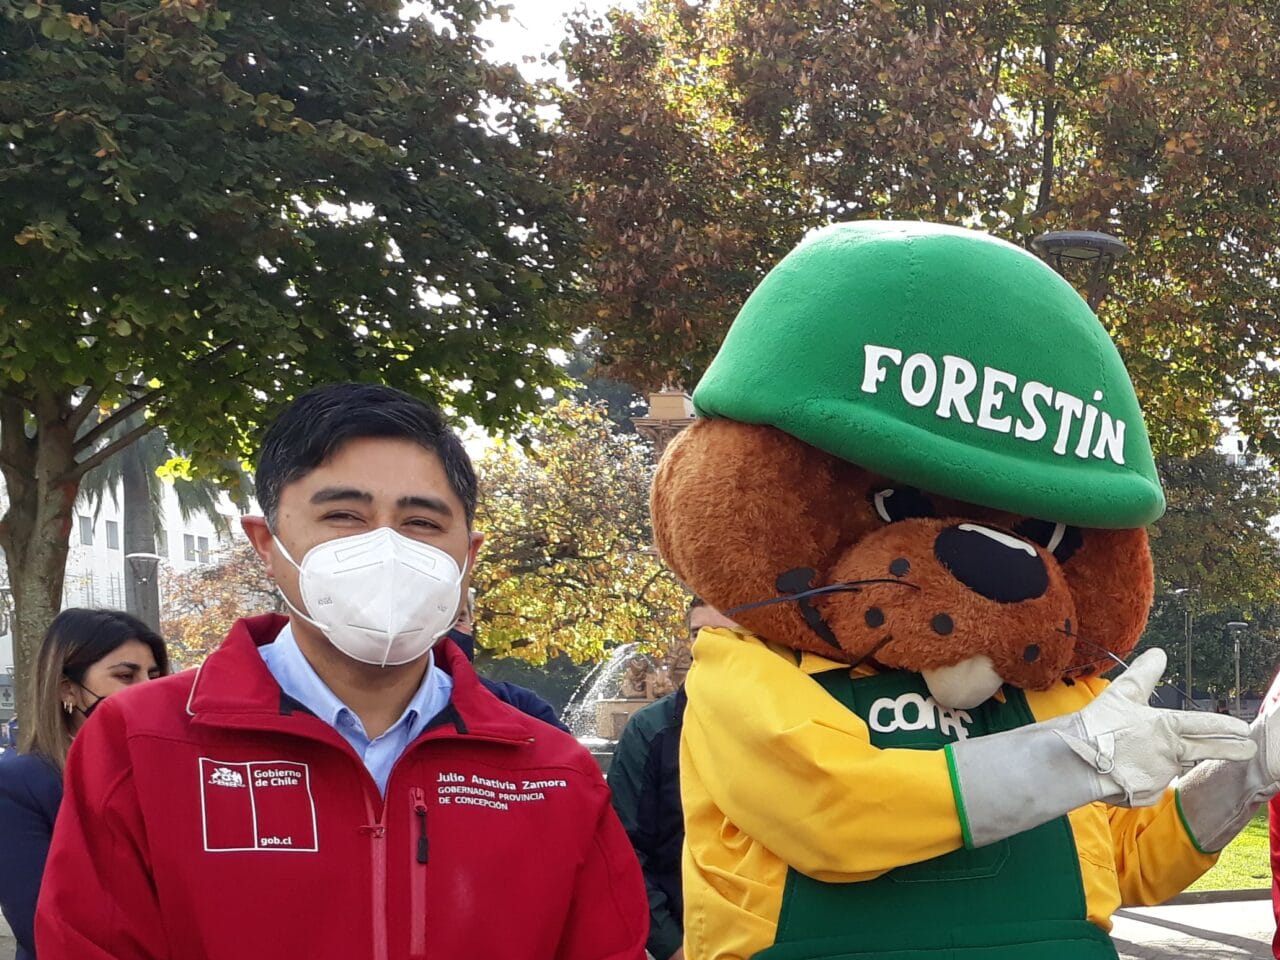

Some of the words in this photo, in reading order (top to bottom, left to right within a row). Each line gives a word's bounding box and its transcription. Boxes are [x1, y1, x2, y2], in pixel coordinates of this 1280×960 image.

[254, 768, 302, 780] Gobierno
[255, 778, 269, 787] de
[270, 776, 299, 786] Chile
[436, 772, 466, 783] Julio
[471, 774, 517, 791] Anativia
[521, 779, 567, 790] Zamora
[437, 785, 496, 798] GOBERNADOR
[498, 792, 545, 802] PROVINCIA
[438, 796, 451, 804] DE
[454, 796, 509, 811] CONCEPCIÓN
[260, 835, 293, 848] gob.cl
